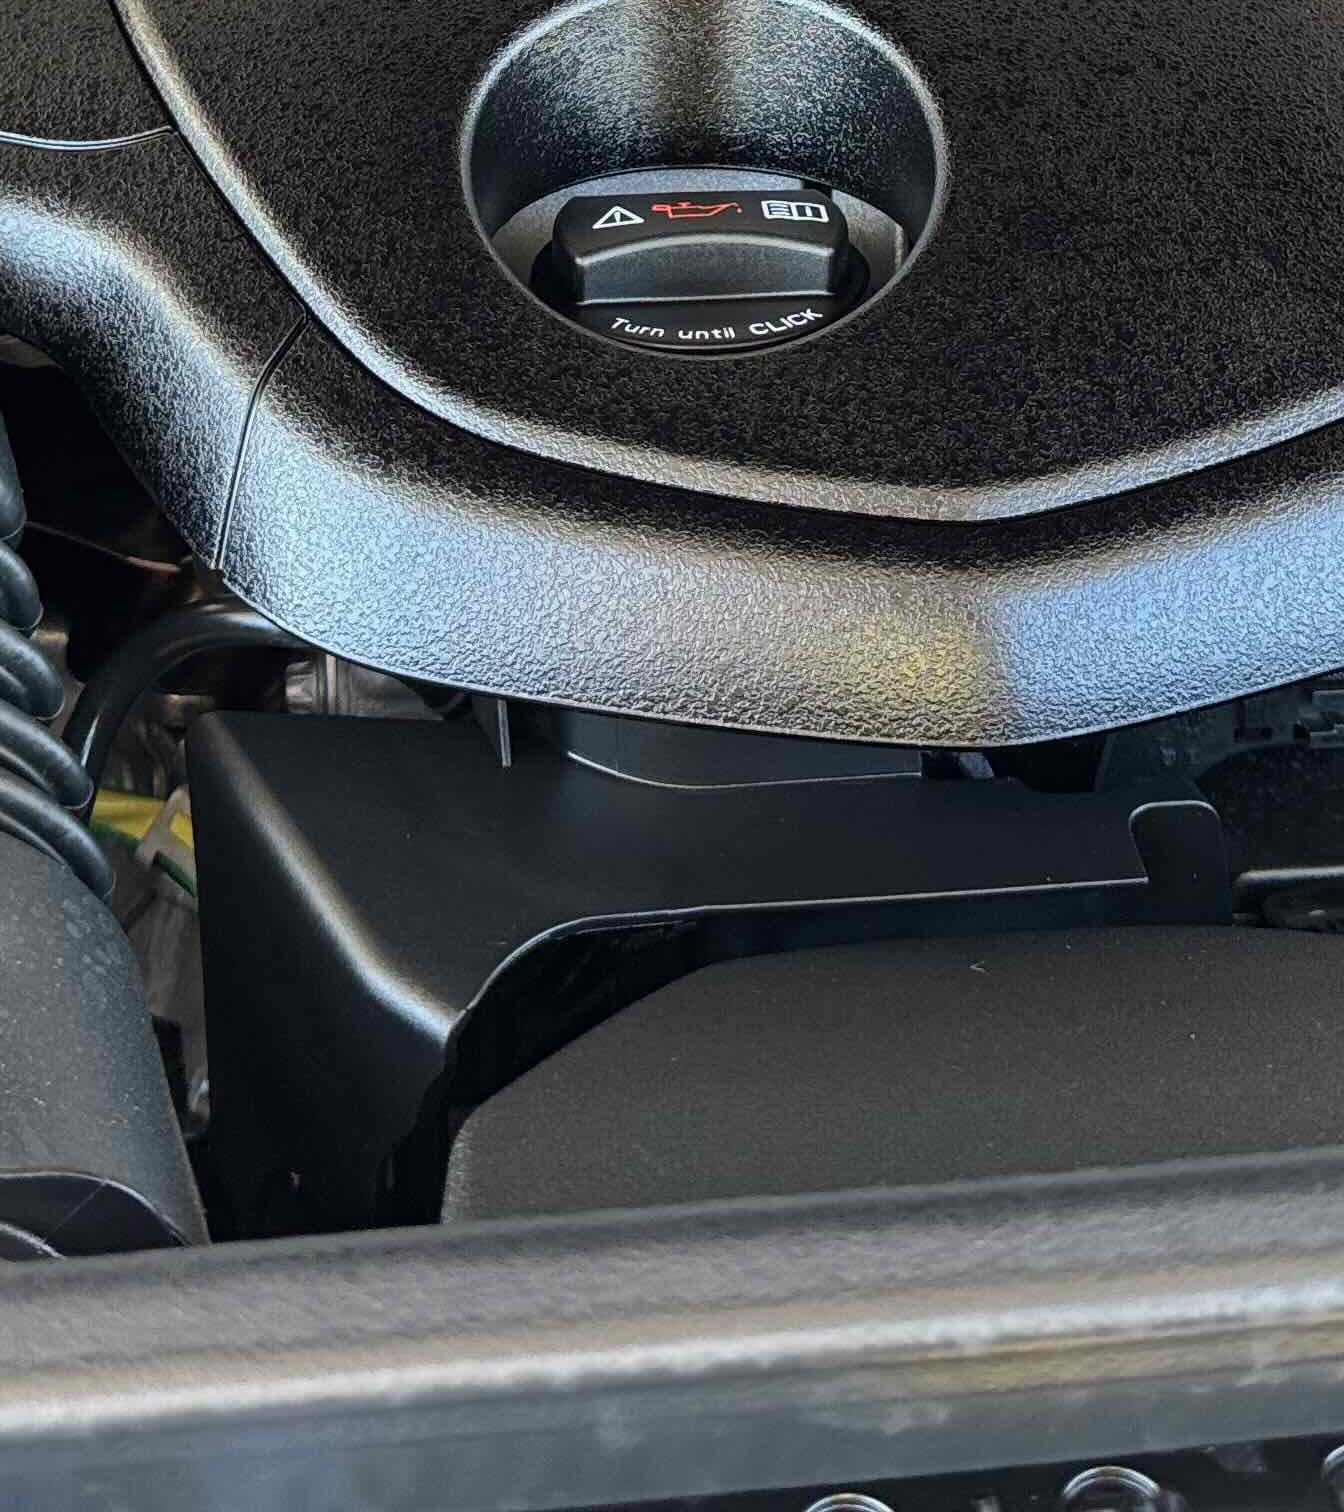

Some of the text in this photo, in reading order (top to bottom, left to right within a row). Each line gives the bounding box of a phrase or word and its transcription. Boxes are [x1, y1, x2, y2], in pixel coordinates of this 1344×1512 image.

[610, 308, 823, 340] Turn until CLICK
